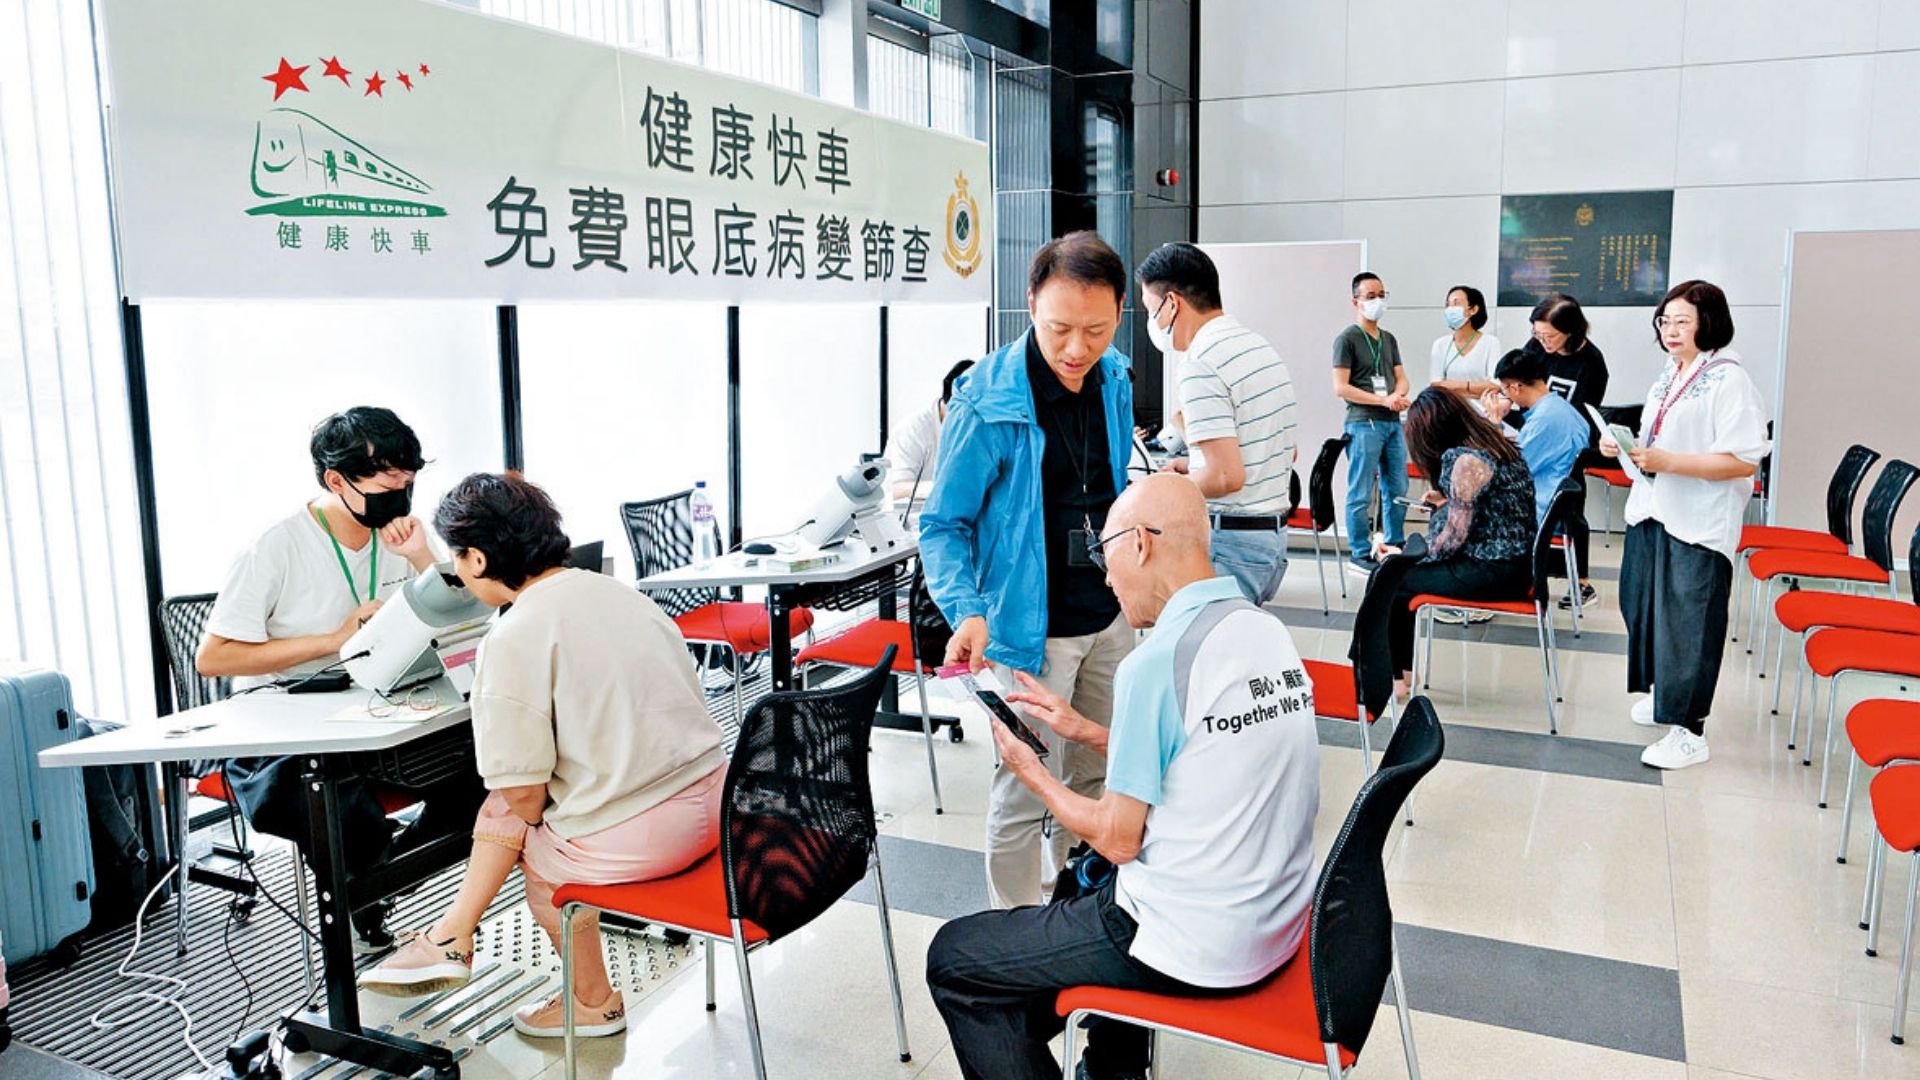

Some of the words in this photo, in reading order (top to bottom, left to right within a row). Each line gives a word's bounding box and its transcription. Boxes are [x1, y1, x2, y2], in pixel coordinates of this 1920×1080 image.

[640, 85, 852, 195] 健康快車
[302, 198, 366, 212] LIFELINE
[369, 202, 428, 216] EXPRESS
[276, 220, 432, 255] 健康快車
[484, 175, 931, 283] 免費眼底病變篩查
[1202, 703, 1278, 734] Together
[1279, 696, 1300, 714] We
